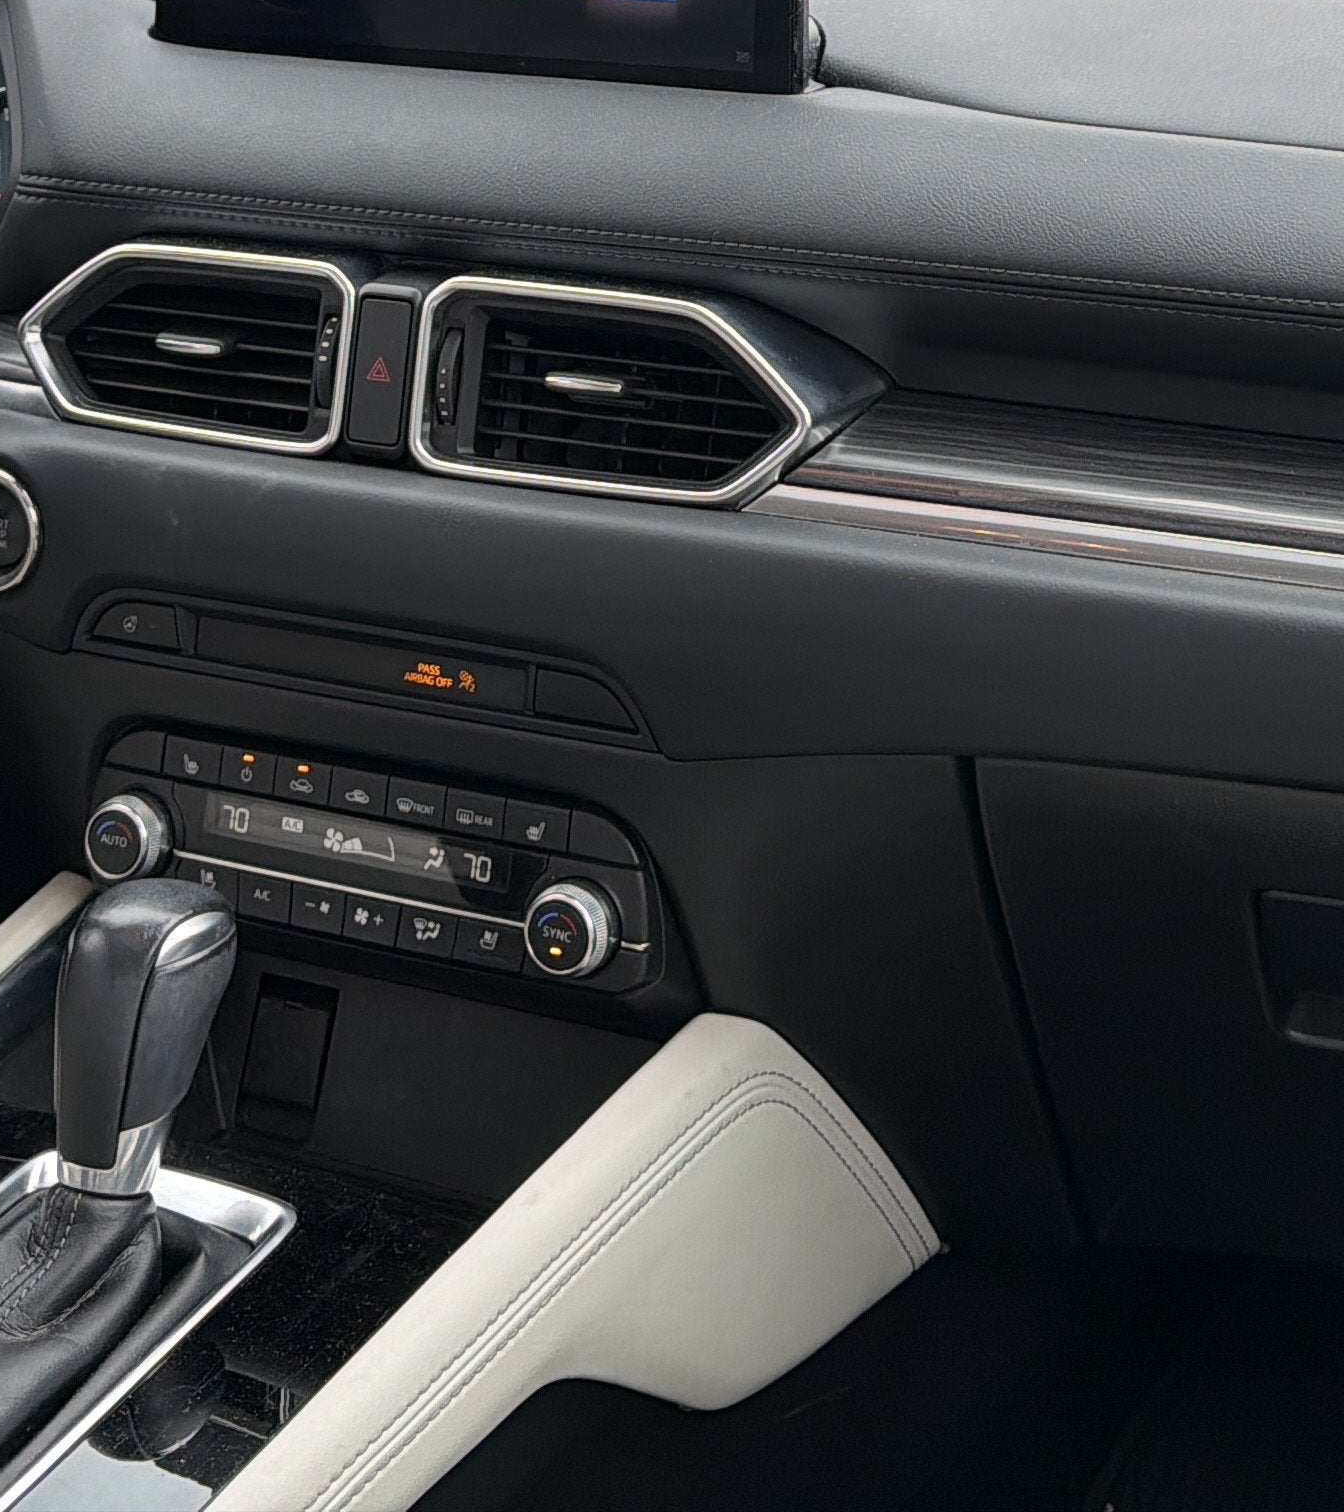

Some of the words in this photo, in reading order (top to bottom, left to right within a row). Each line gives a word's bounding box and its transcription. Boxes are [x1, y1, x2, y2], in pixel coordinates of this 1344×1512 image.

[417, 662, 441, 675] PASS
[403, 671, 435, 686] AIRBAG
[436, 676, 453, 689] OFF
[413, 803, 435, 815] FRONT
[223, 804, 250, 834] 70
[474, 816, 494, 827] REAR
[99, 832, 128, 848] AUTO
[463, 852, 492, 883] 70
[252, 888, 272, 902] A/C
[542, 926, 573, 944] SYNC
